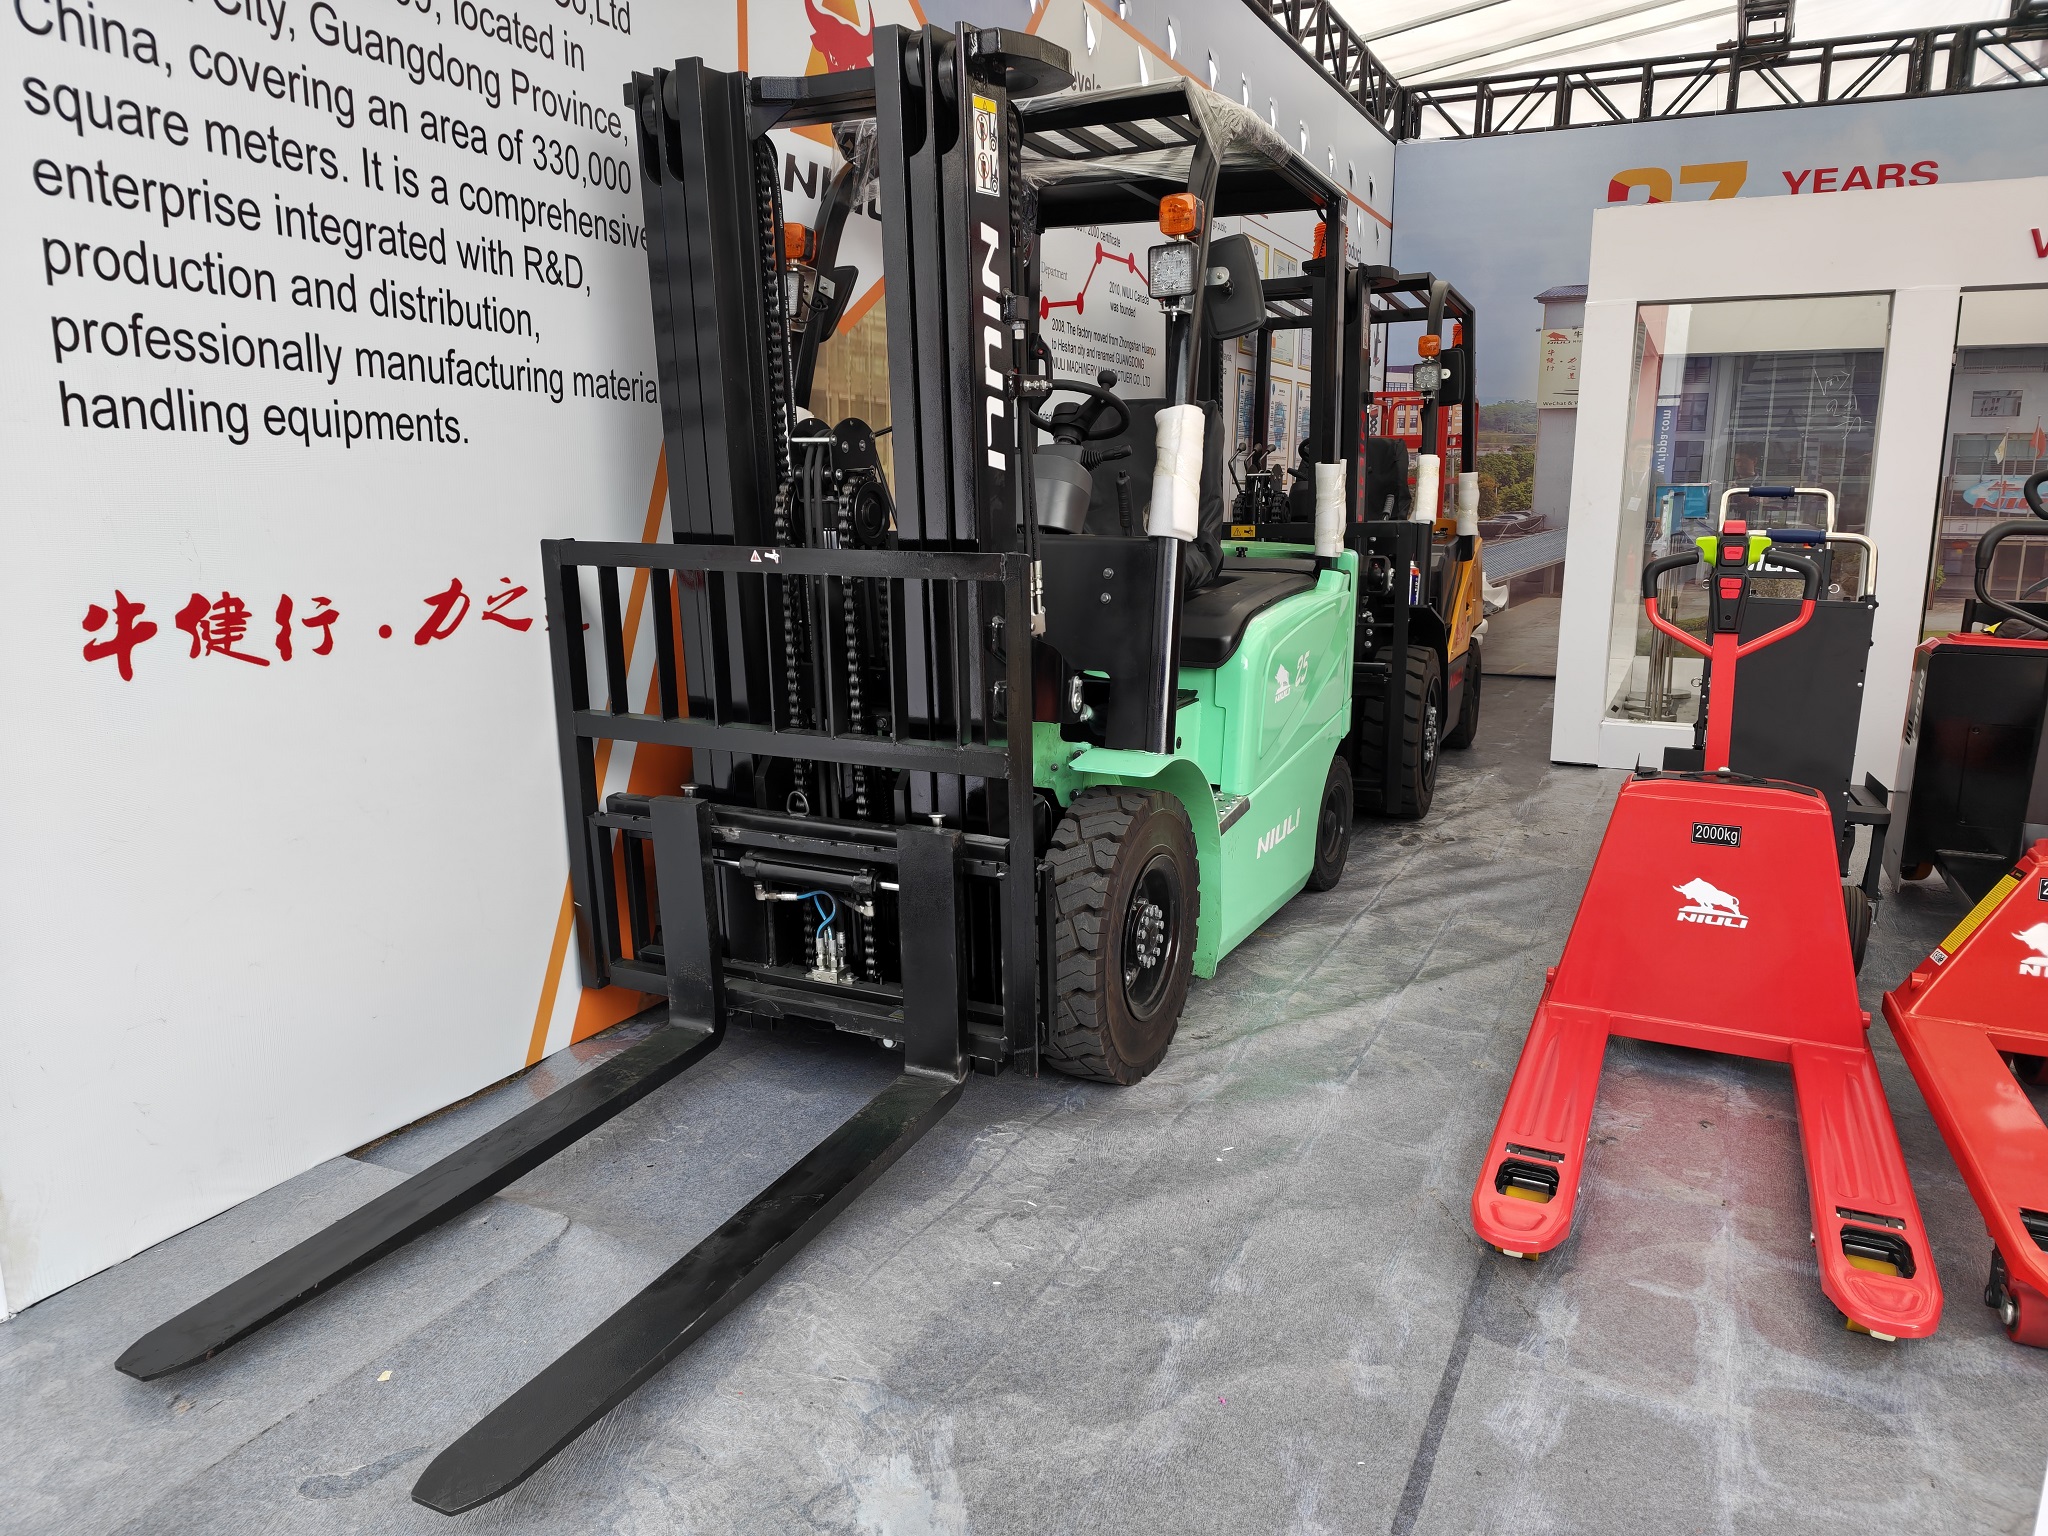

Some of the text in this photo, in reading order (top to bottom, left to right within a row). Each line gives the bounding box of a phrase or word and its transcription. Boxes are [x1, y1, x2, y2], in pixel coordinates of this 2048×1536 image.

[555, 0, 631, 35] o,Ltd
[453, 0, 555, 60] located
[563, 30, 586, 72] in
[310, 2, 500, 109] Guangdong
[511, 68, 629, 147] Province,
[14, 0, 631, 195] China, covering an area of 330,000
[22, 76, 647, 251] square meters. It is a comprehensive
[1782, 160, 1939, 195] YEARS
[32, 158, 591, 298] enterprise integrated with R&D,
[1100, 230, 1121, 248] certificate
[1041, 260, 1068, 280] Department
[42, 237, 540, 344] production and distribution,
[1122, 285, 1134, 300] NIULI
[1134, 290, 1150, 306] Canada
[1109, 301, 1137, 318] was founded
[980, 221, 1007, 471] NIULI
[1051, 337, 1145, 370] to Heshan city and renamed GUANGDONG
[1066, 321, 1076, 336] The
[1076, 324, 1092, 343] factory
[1093, 331, 1108, 345] moved
[1109, 333, 1118, 347] from
[1119, 335, 1141, 353] Zhongshan
[51, 312, 342, 385] professionally
[356, 348, 563, 404] manufacturing
[1066, 359, 1098, 377] MACHINERY
[59, 380, 469, 448] handling equipments.
[1256, 807, 1301, 860] NIULI
[1695, 825, 1738, 844] 2000kg
[1676, 911, 1749, 929] NIULI
